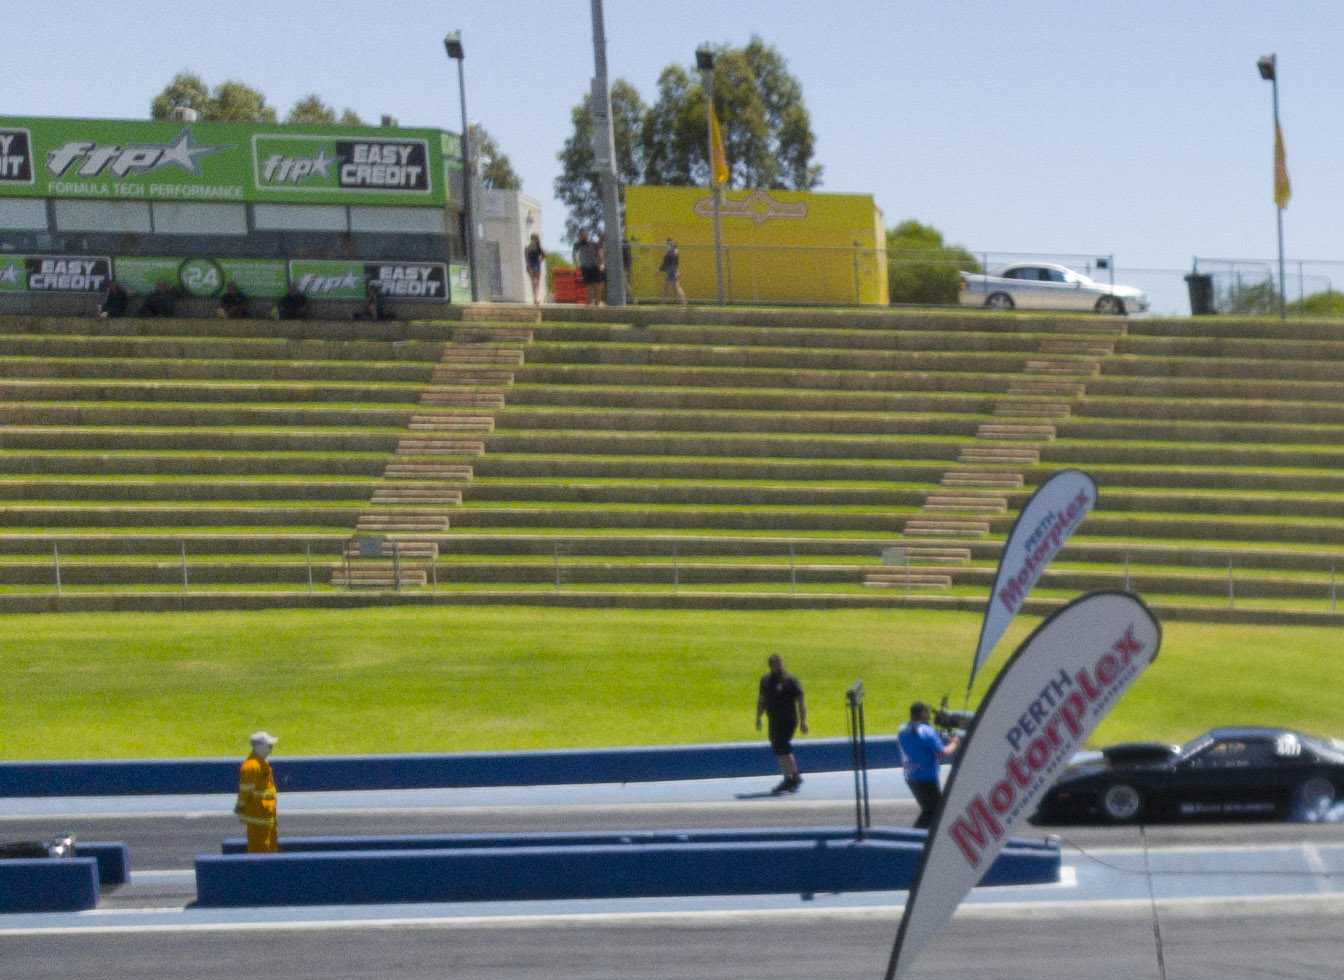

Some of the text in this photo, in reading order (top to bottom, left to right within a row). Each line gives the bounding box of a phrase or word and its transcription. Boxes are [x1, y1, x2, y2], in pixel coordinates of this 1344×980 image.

[353, 143, 414, 165] EASY
[341, 163, 423, 187] CREDIT
[49, 182, 244, 198] FORMULA TECH PERFORMANCE
[41, 260, 96, 274] EASY
[379, 265, 432, 280] EASY
[30, 273, 105, 290] CREDIT
[1024, 509, 1056, 553] PERTH
[999, 487, 1089, 614] Motorplex
[1006, 668, 1074, 752] PERTH
[948, 622, 1147, 870] Motorplex
